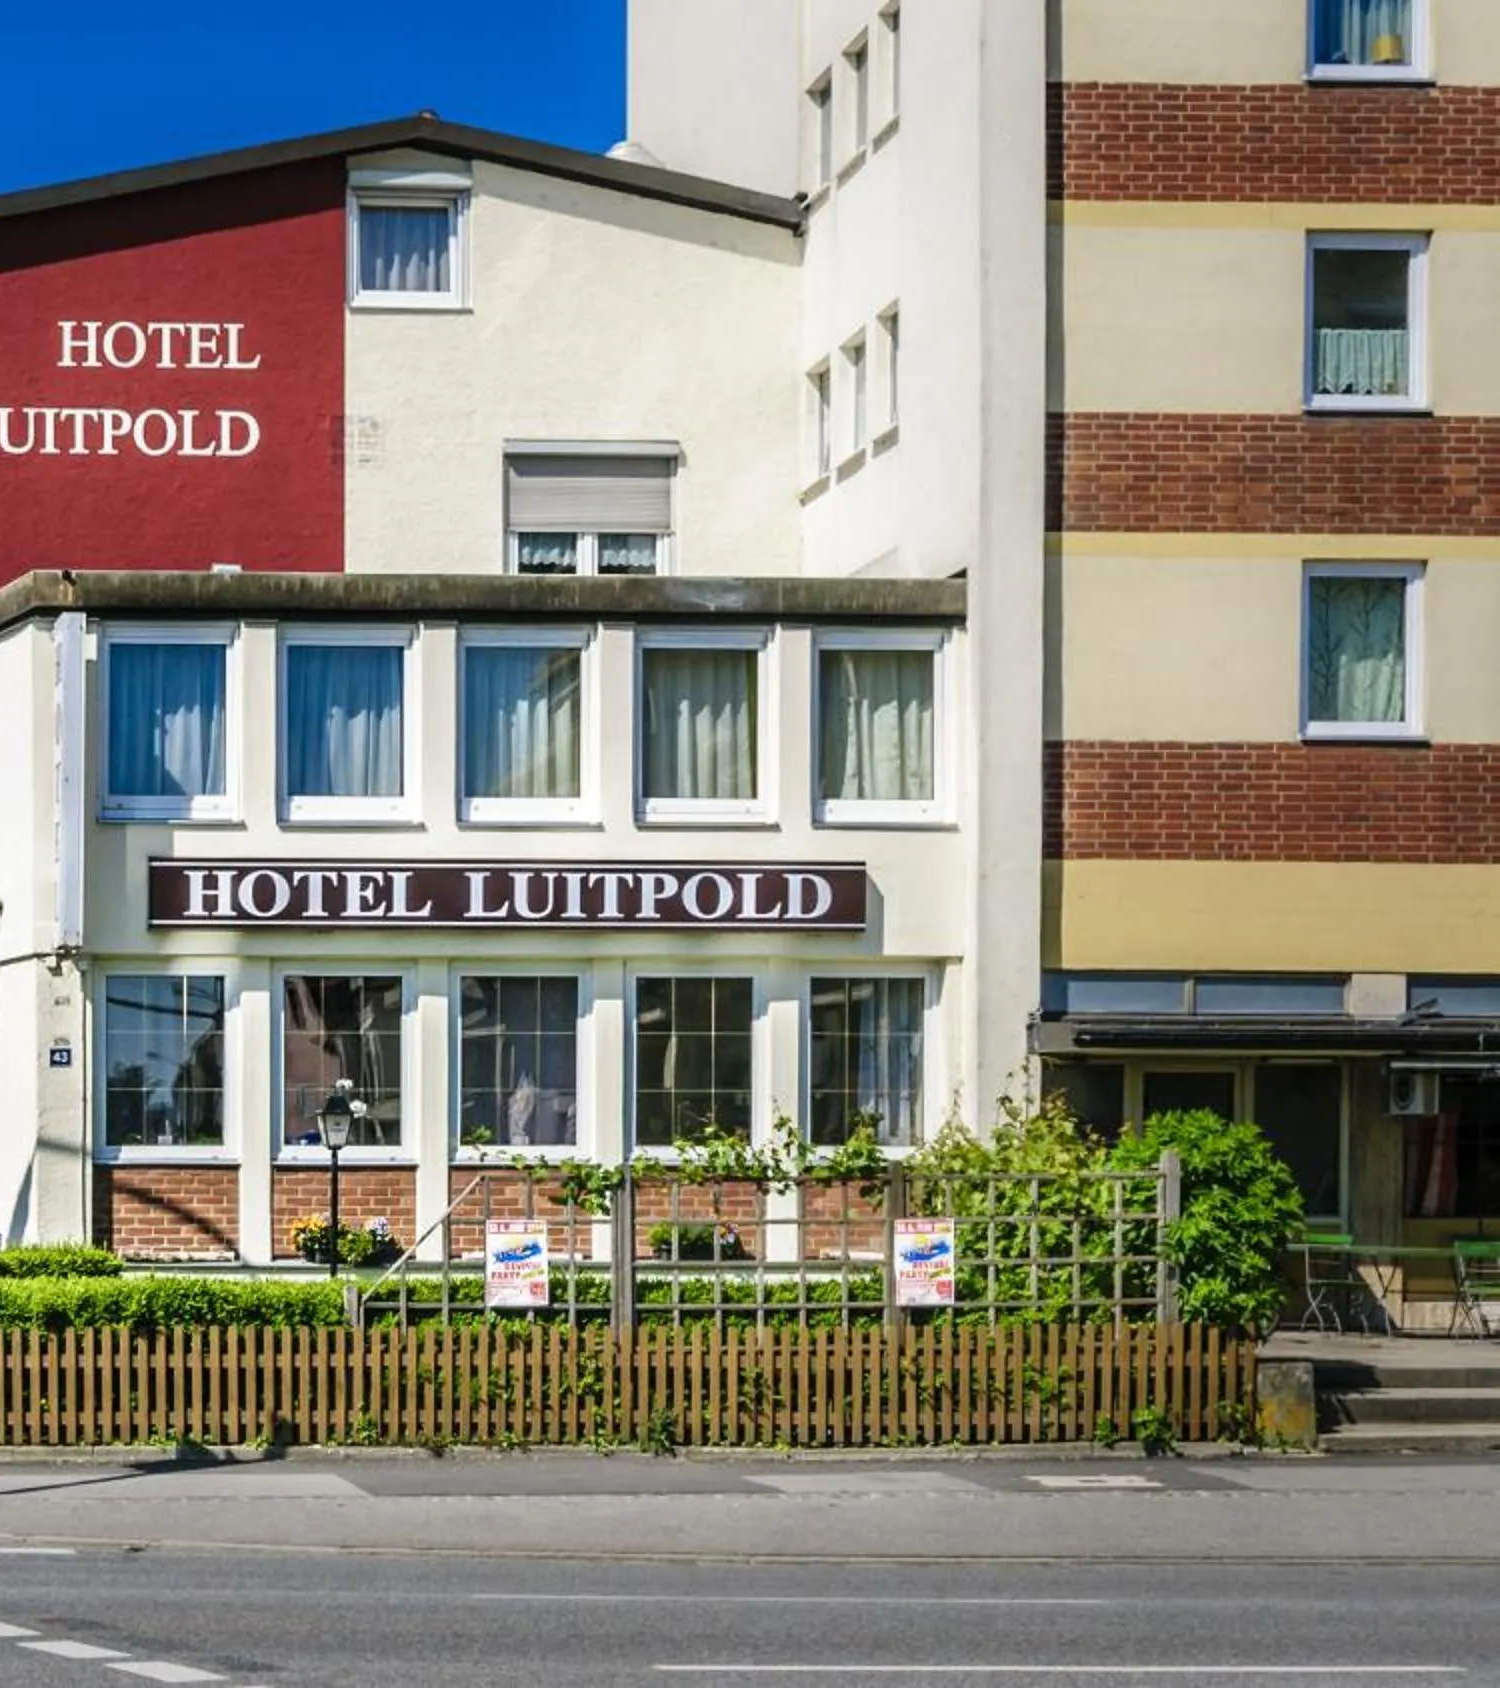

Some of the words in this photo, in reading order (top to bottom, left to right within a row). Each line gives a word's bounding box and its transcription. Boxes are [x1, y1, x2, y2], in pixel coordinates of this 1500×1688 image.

[56, 321, 261, 369] HOTEL
[183, 869, 433, 917] HOTEL
[463, 871, 833, 919] LUITPOLD
[52, 1051, 69, 1063] 43
